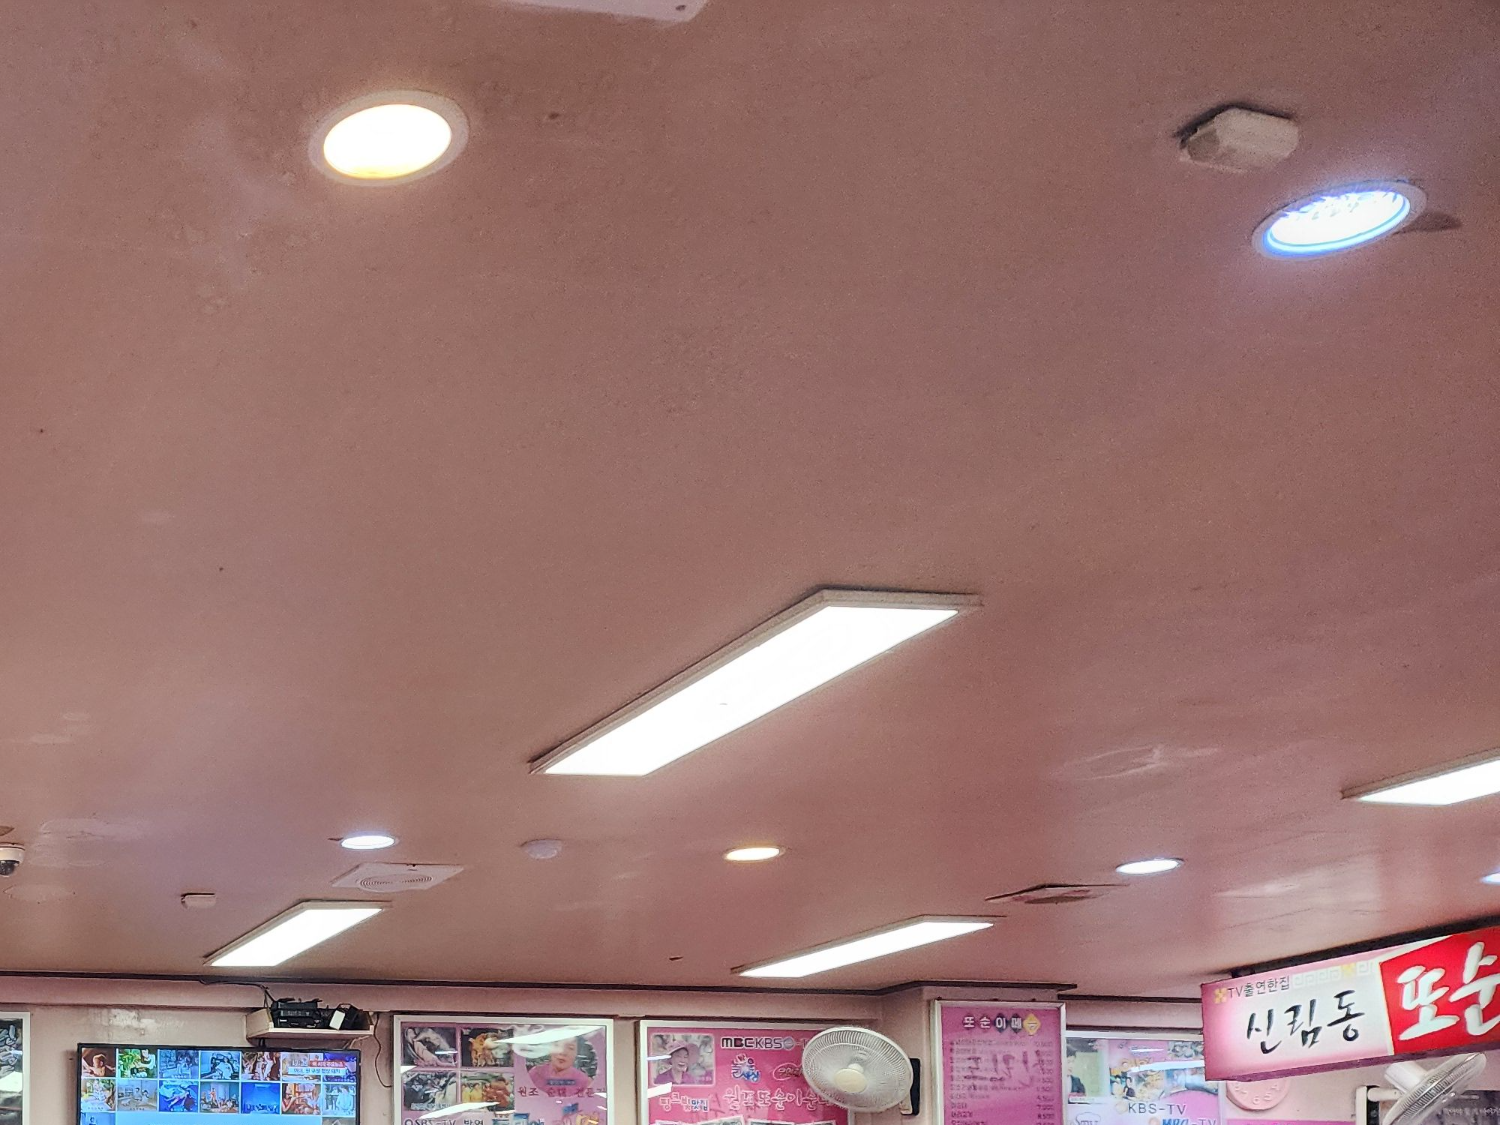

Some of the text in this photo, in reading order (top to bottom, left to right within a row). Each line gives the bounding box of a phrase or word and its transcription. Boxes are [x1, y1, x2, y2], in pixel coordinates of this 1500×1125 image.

[1228, 975, 1290, 999] TV출연한집
[1247, 989, 1365, 1054] 신림동
[518, 1086, 539, 1097] 원조
[1128, 1103, 1187, 1116] KBS-TV
